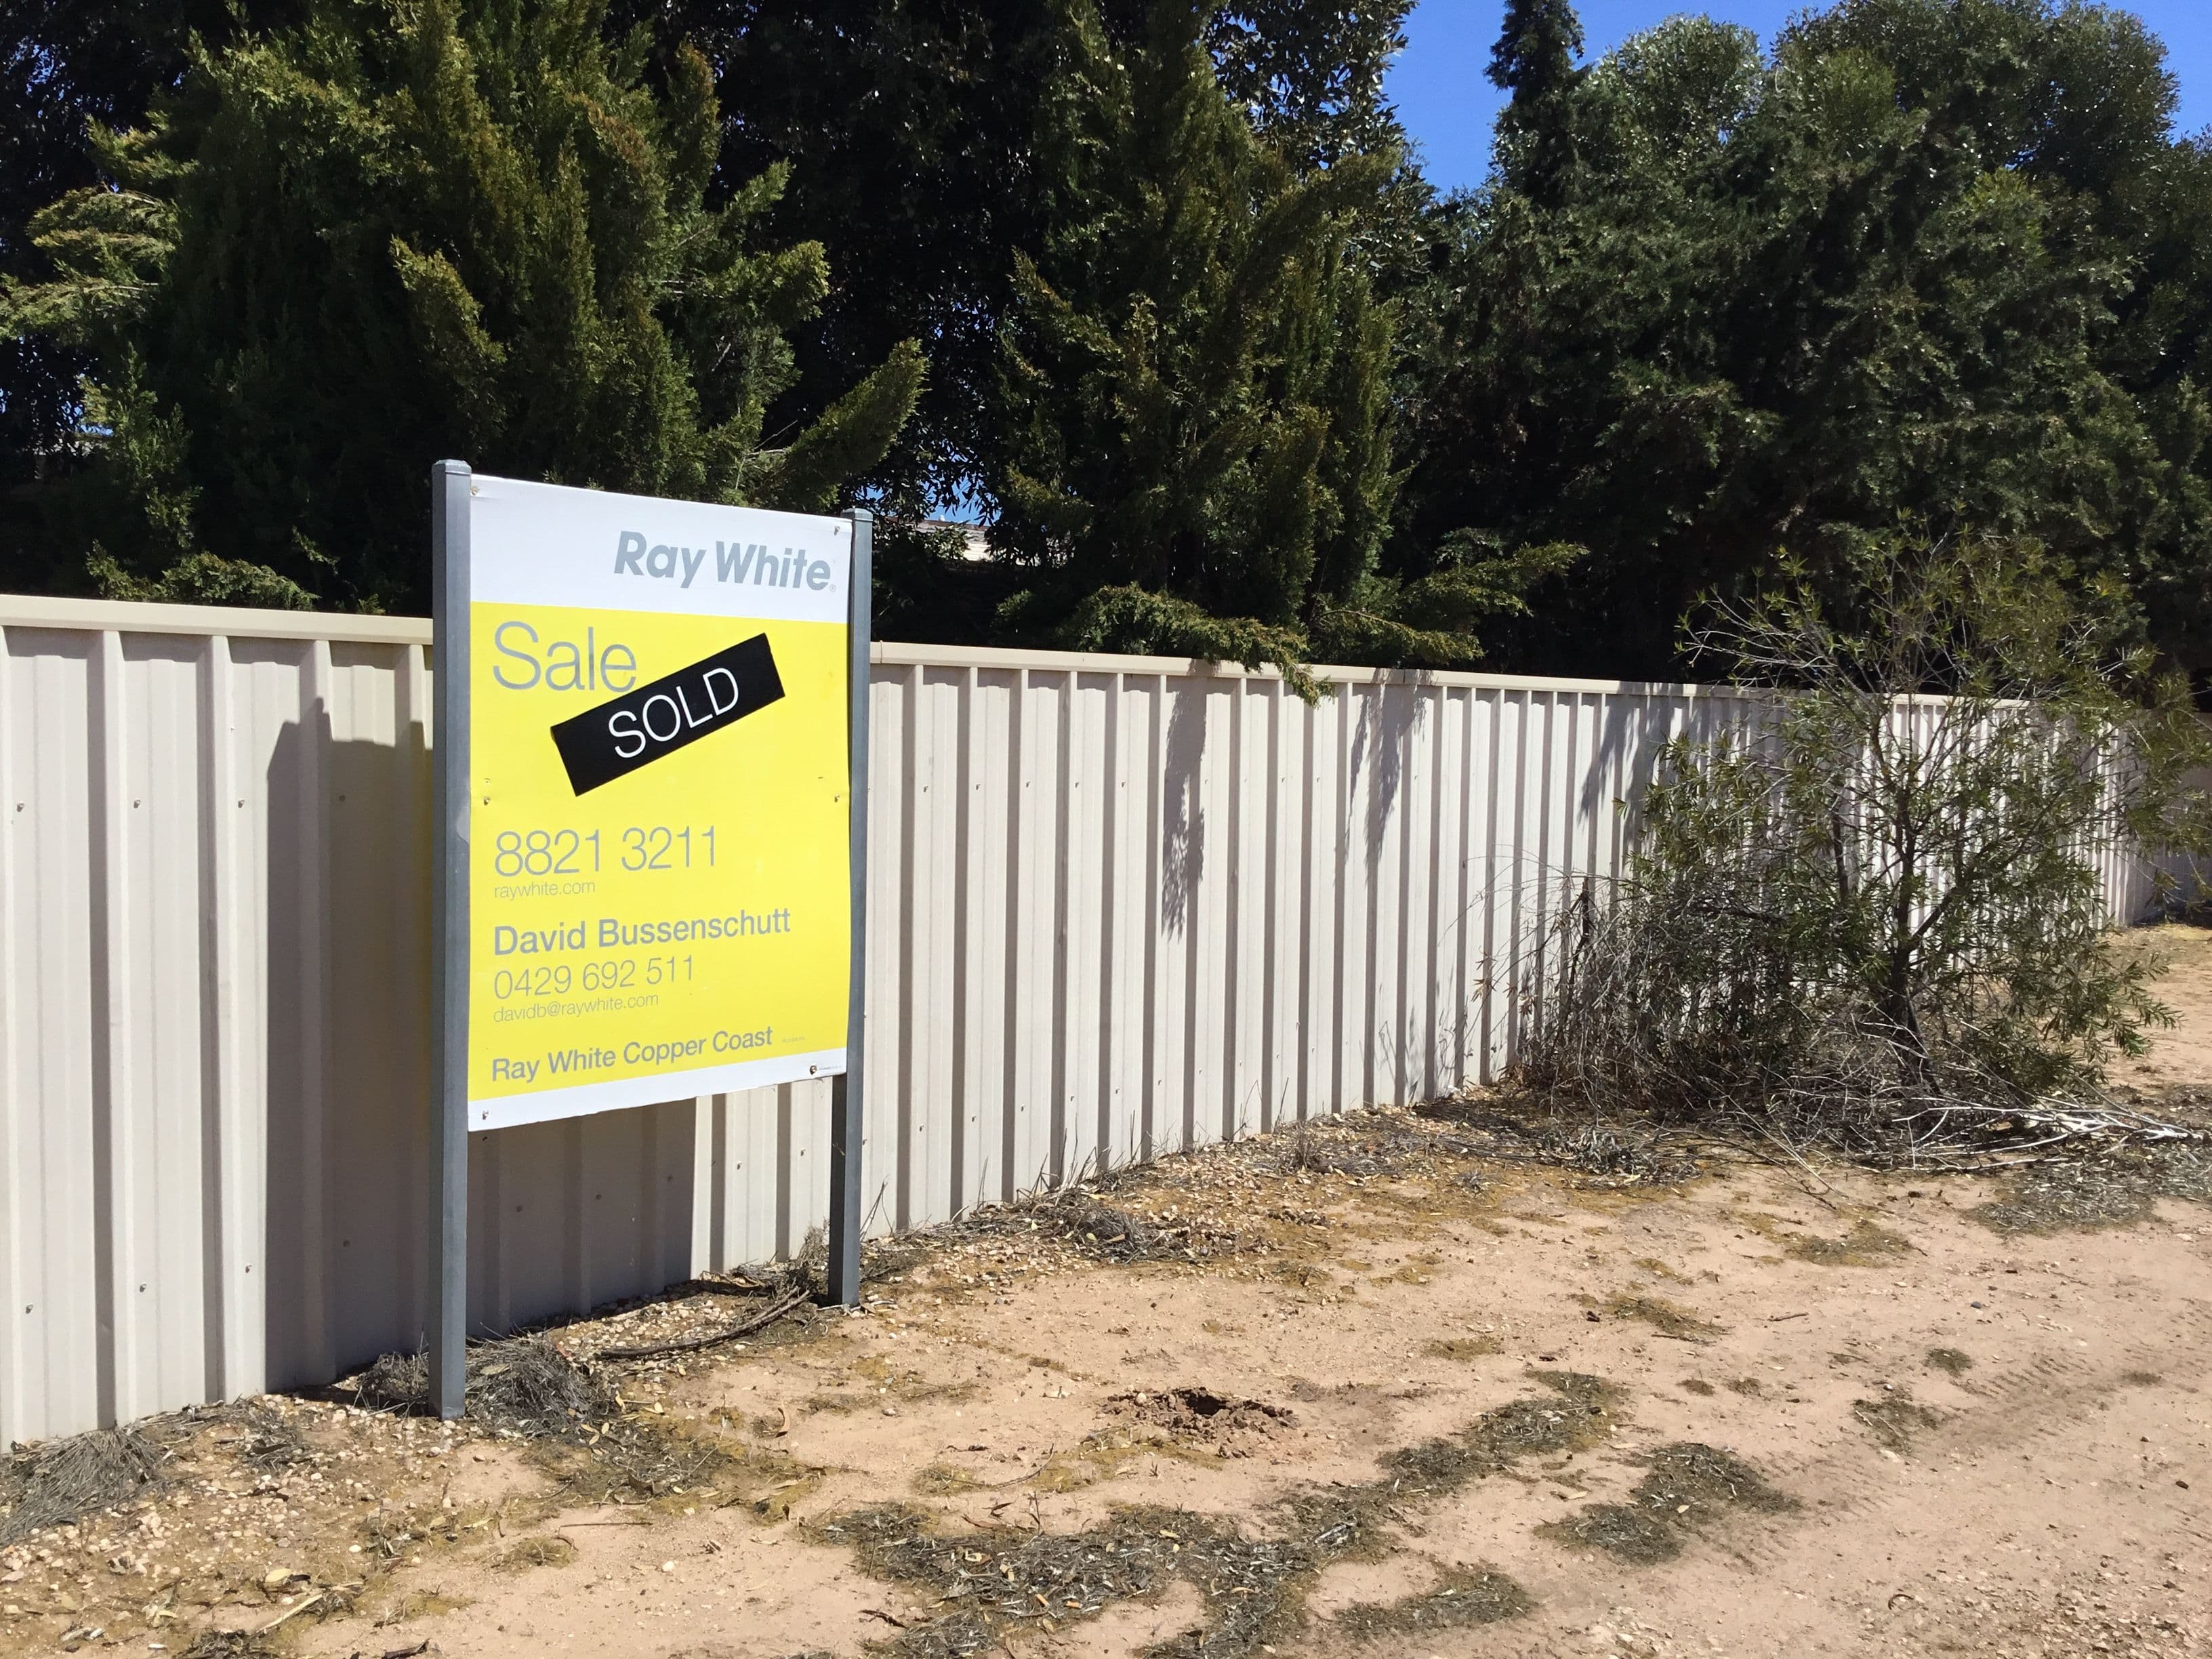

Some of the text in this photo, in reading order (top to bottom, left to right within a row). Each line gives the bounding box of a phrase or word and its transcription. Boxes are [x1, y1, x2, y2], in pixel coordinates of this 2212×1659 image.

[613, 531, 832, 591] Ray White
[493, 620, 636, 693] Sale
[609, 667, 739, 758] SOLD
[494, 825, 716, 877] 8821 3211
[494, 880, 596, 901] raywhite.com
[494, 907, 791, 956] David Bussenschutt
[494, 954, 693, 1000] 0429 692 511
[493, 993, 659, 1023] davidb@raywhite.com
[491, 1026, 773, 1084] Ray White Copper Coast
